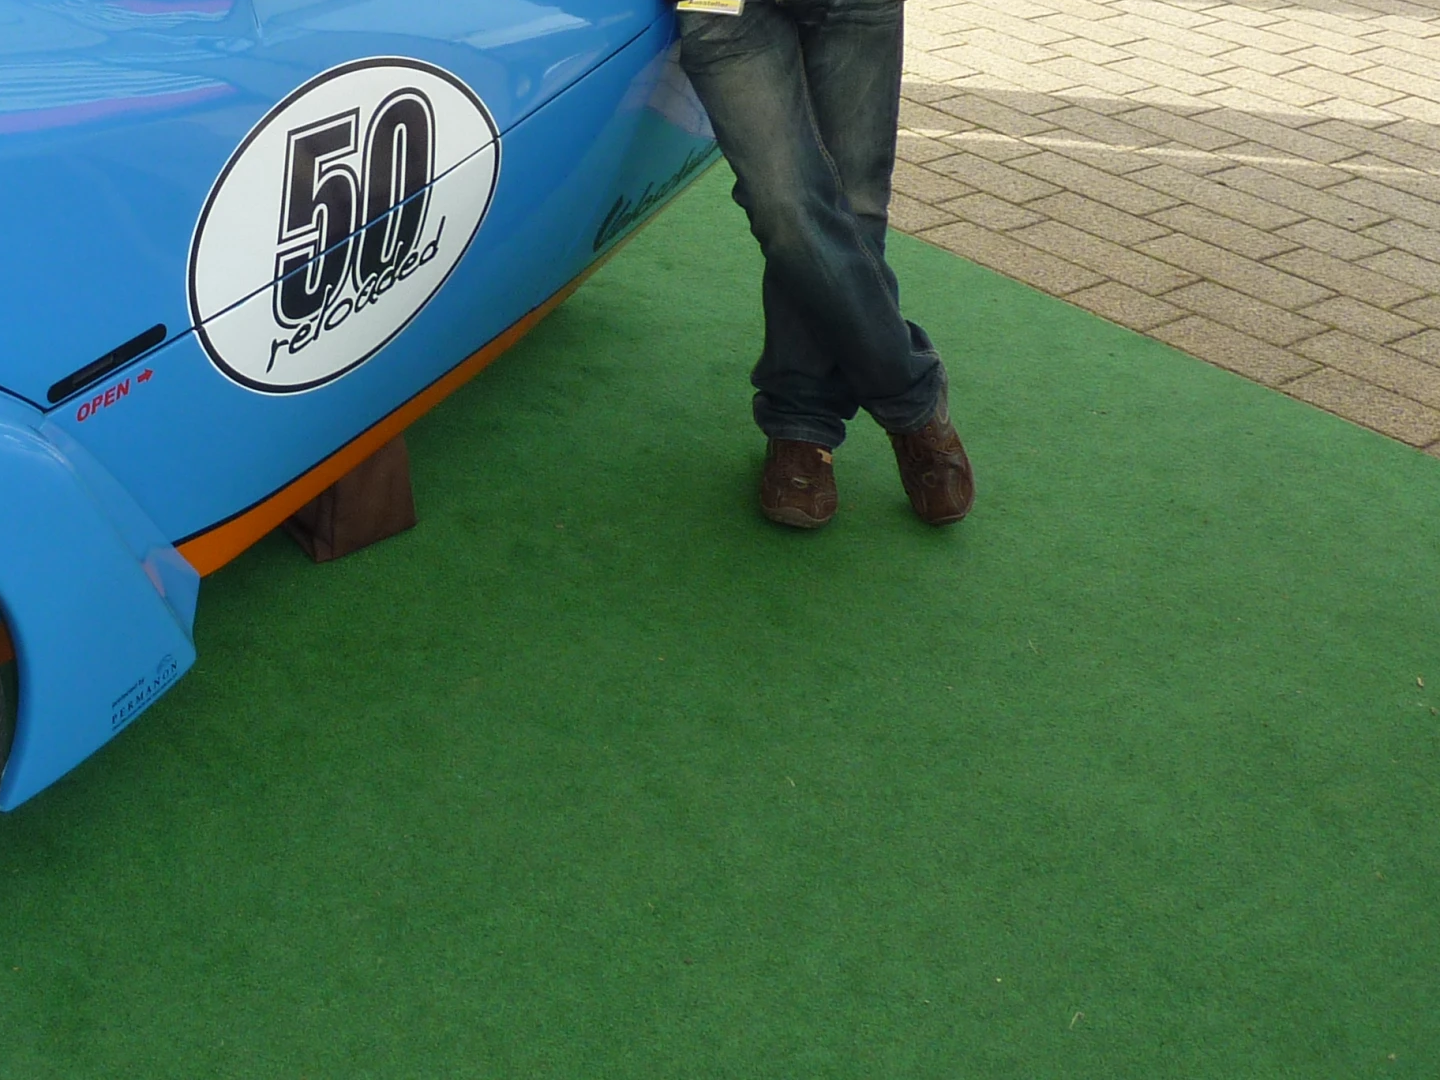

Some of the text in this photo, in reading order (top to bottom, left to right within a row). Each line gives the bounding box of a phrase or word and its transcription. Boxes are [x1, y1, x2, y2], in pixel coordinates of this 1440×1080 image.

[272, 87, 436, 329] 50
[266, 216, 446, 372] reloaded
[76, 378, 132, 422] OPEN
